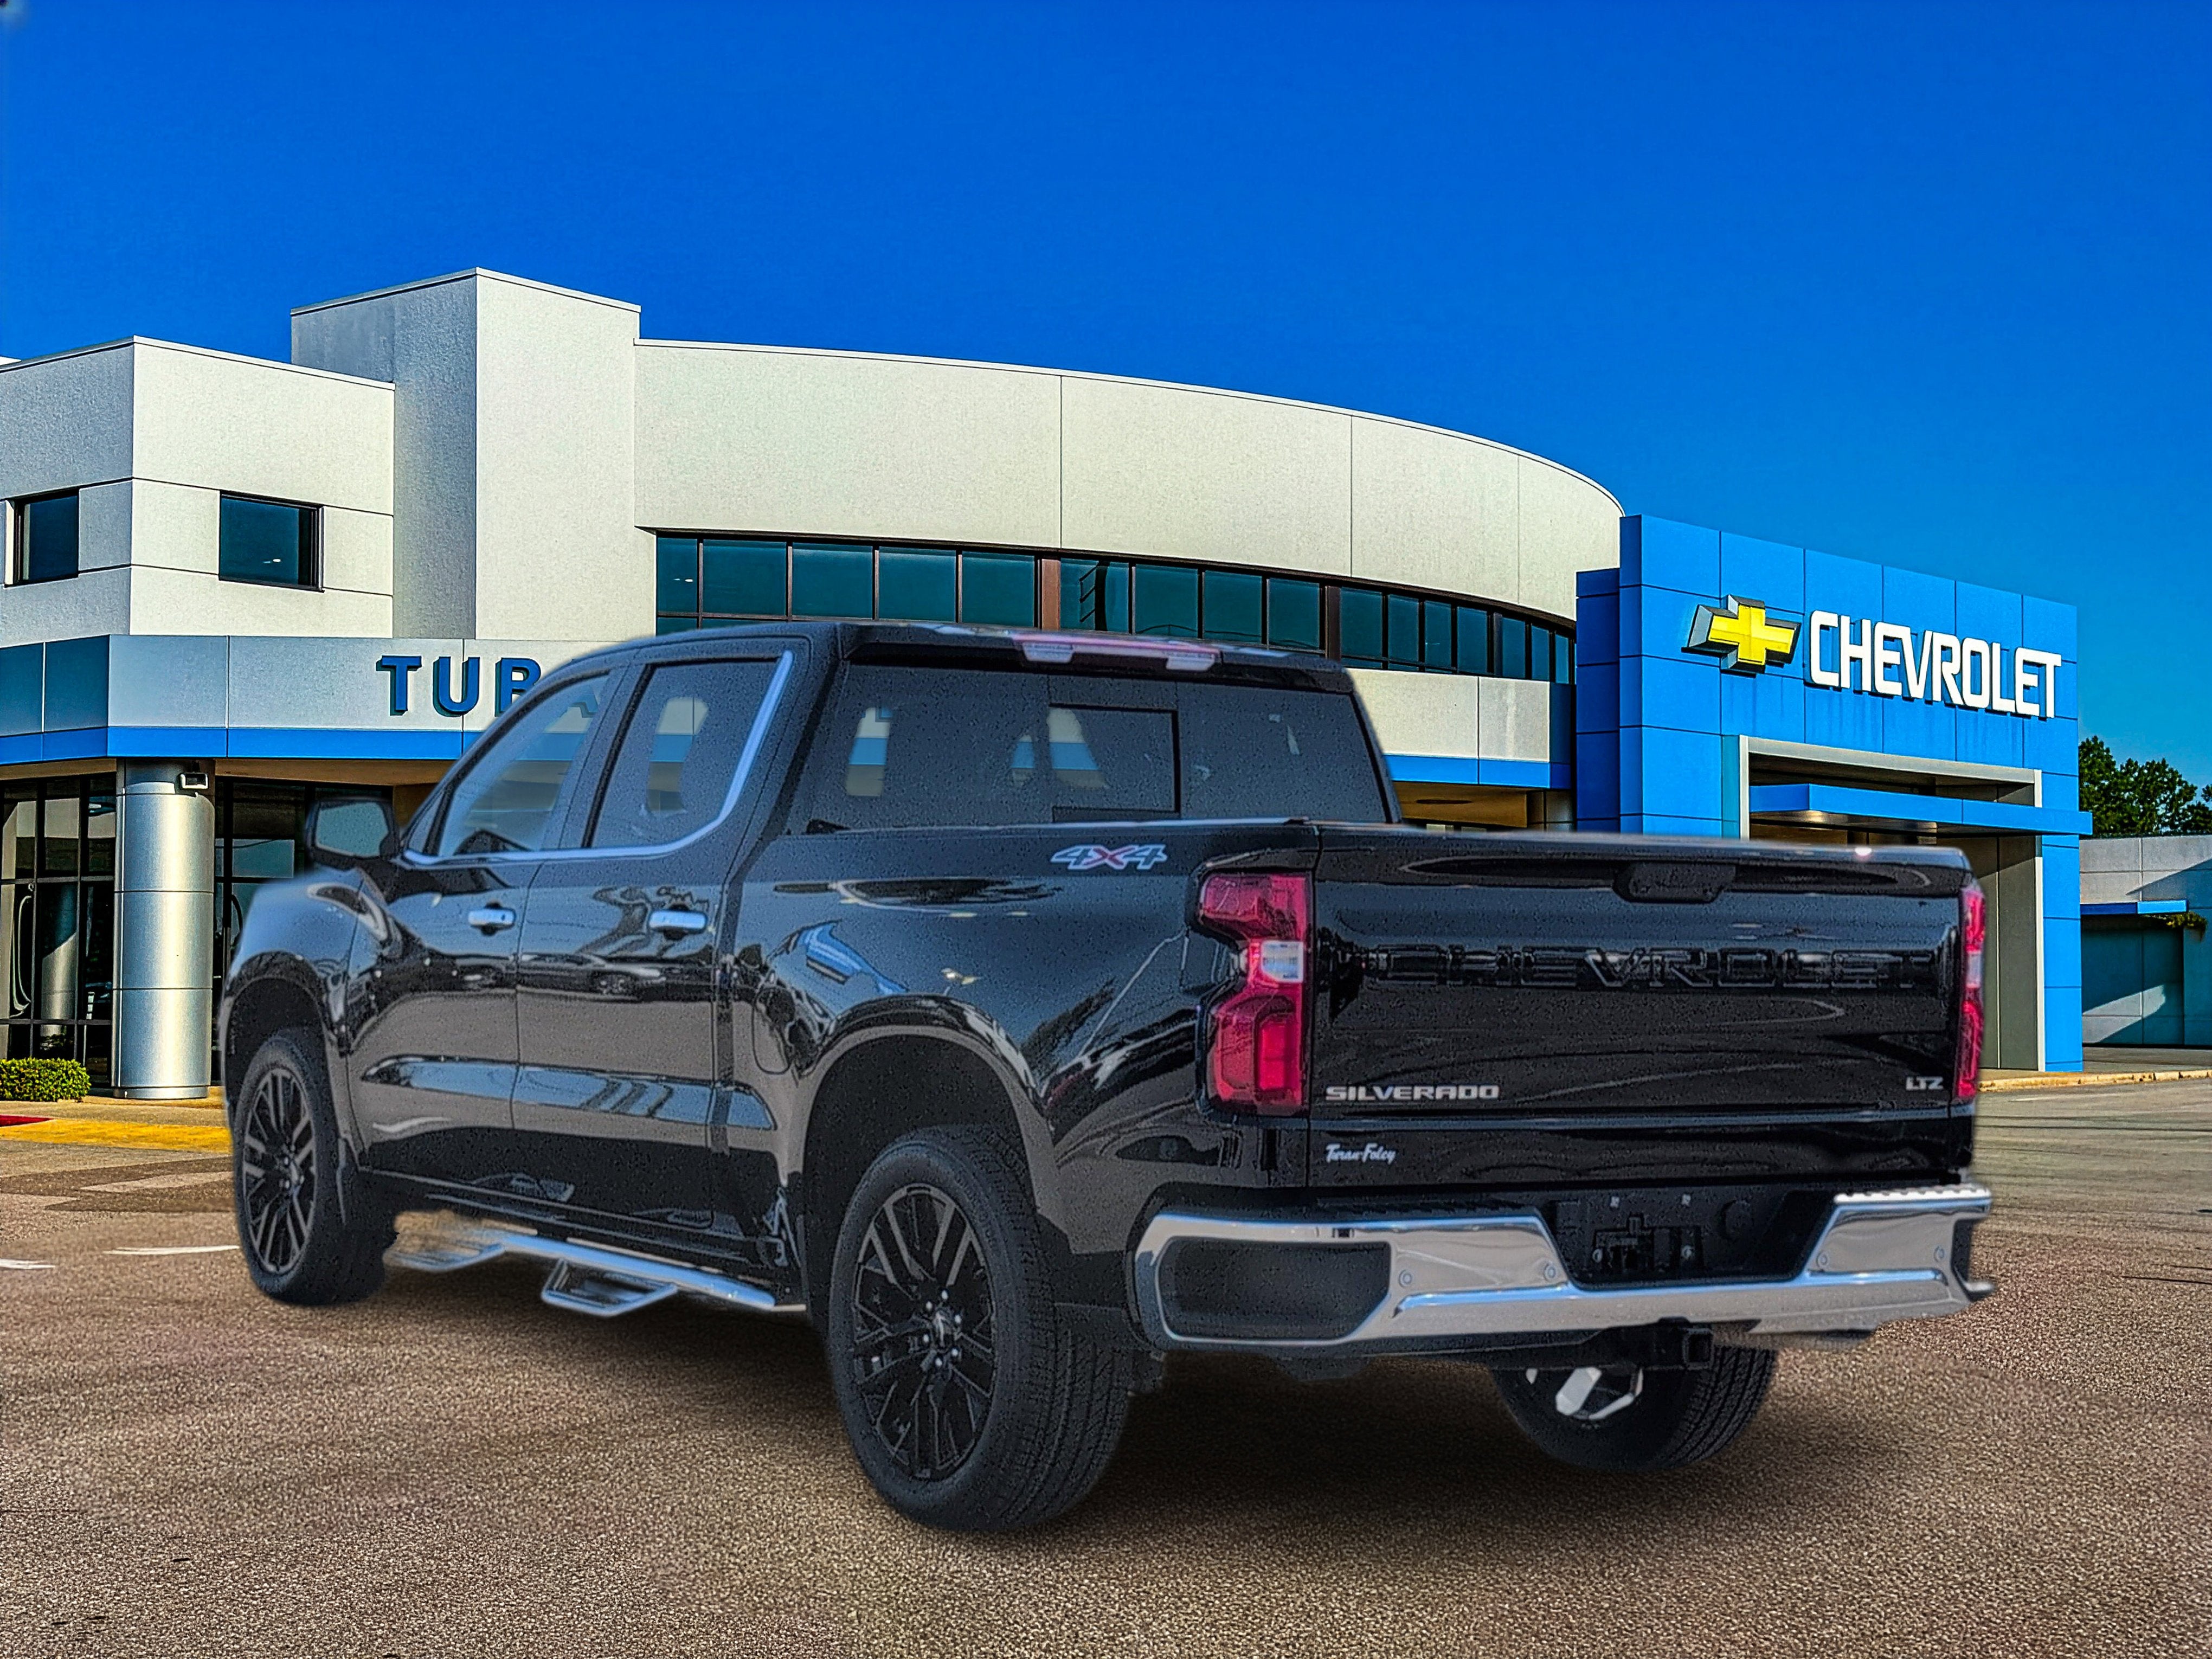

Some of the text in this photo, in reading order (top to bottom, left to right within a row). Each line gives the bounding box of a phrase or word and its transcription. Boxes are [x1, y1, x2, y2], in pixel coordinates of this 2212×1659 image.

[1808, 610, 2061, 718] CHEVROLET
[1906, 1077, 1943, 1090] LTZ
[1326, 1085, 1500, 1101] SILVERADO
